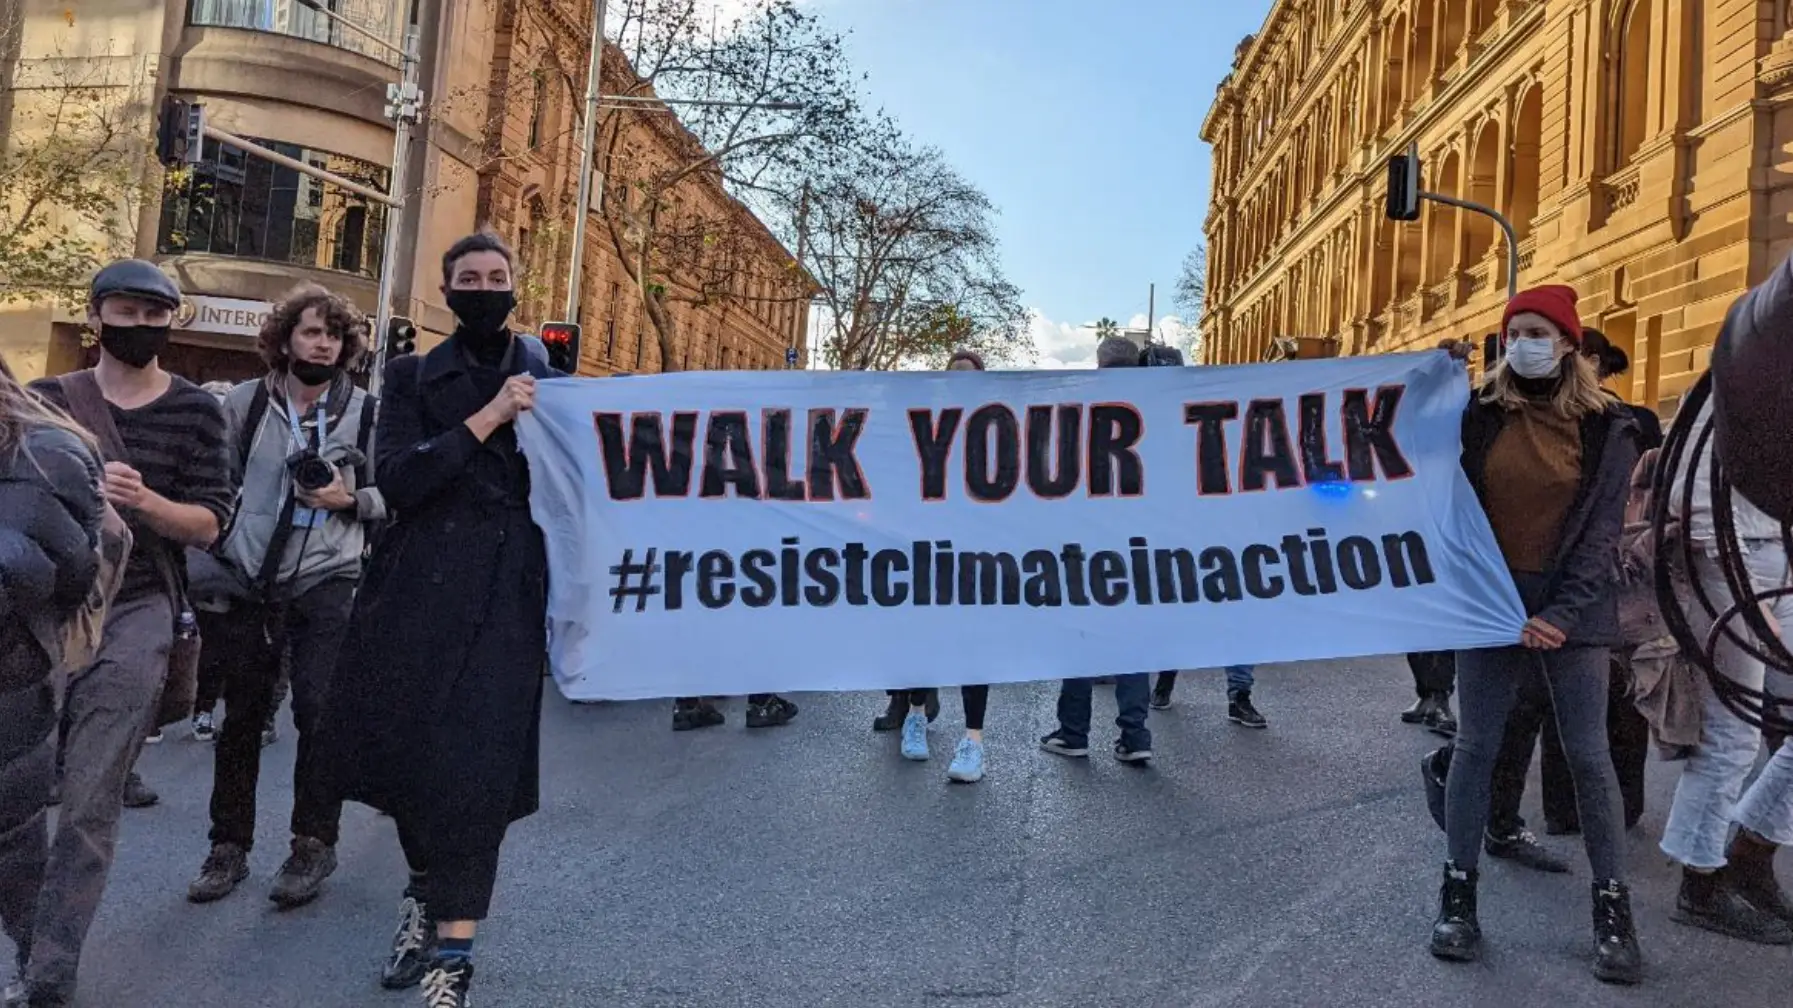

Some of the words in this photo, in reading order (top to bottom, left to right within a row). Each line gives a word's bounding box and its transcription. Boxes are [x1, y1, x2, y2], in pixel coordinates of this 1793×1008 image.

[592, 407, 872, 501] WALK
[906, 401, 1145, 503] YOUR
[1183, 384, 1414, 497] TALK
[608, 529, 1435, 613] #resistclimateinaction
